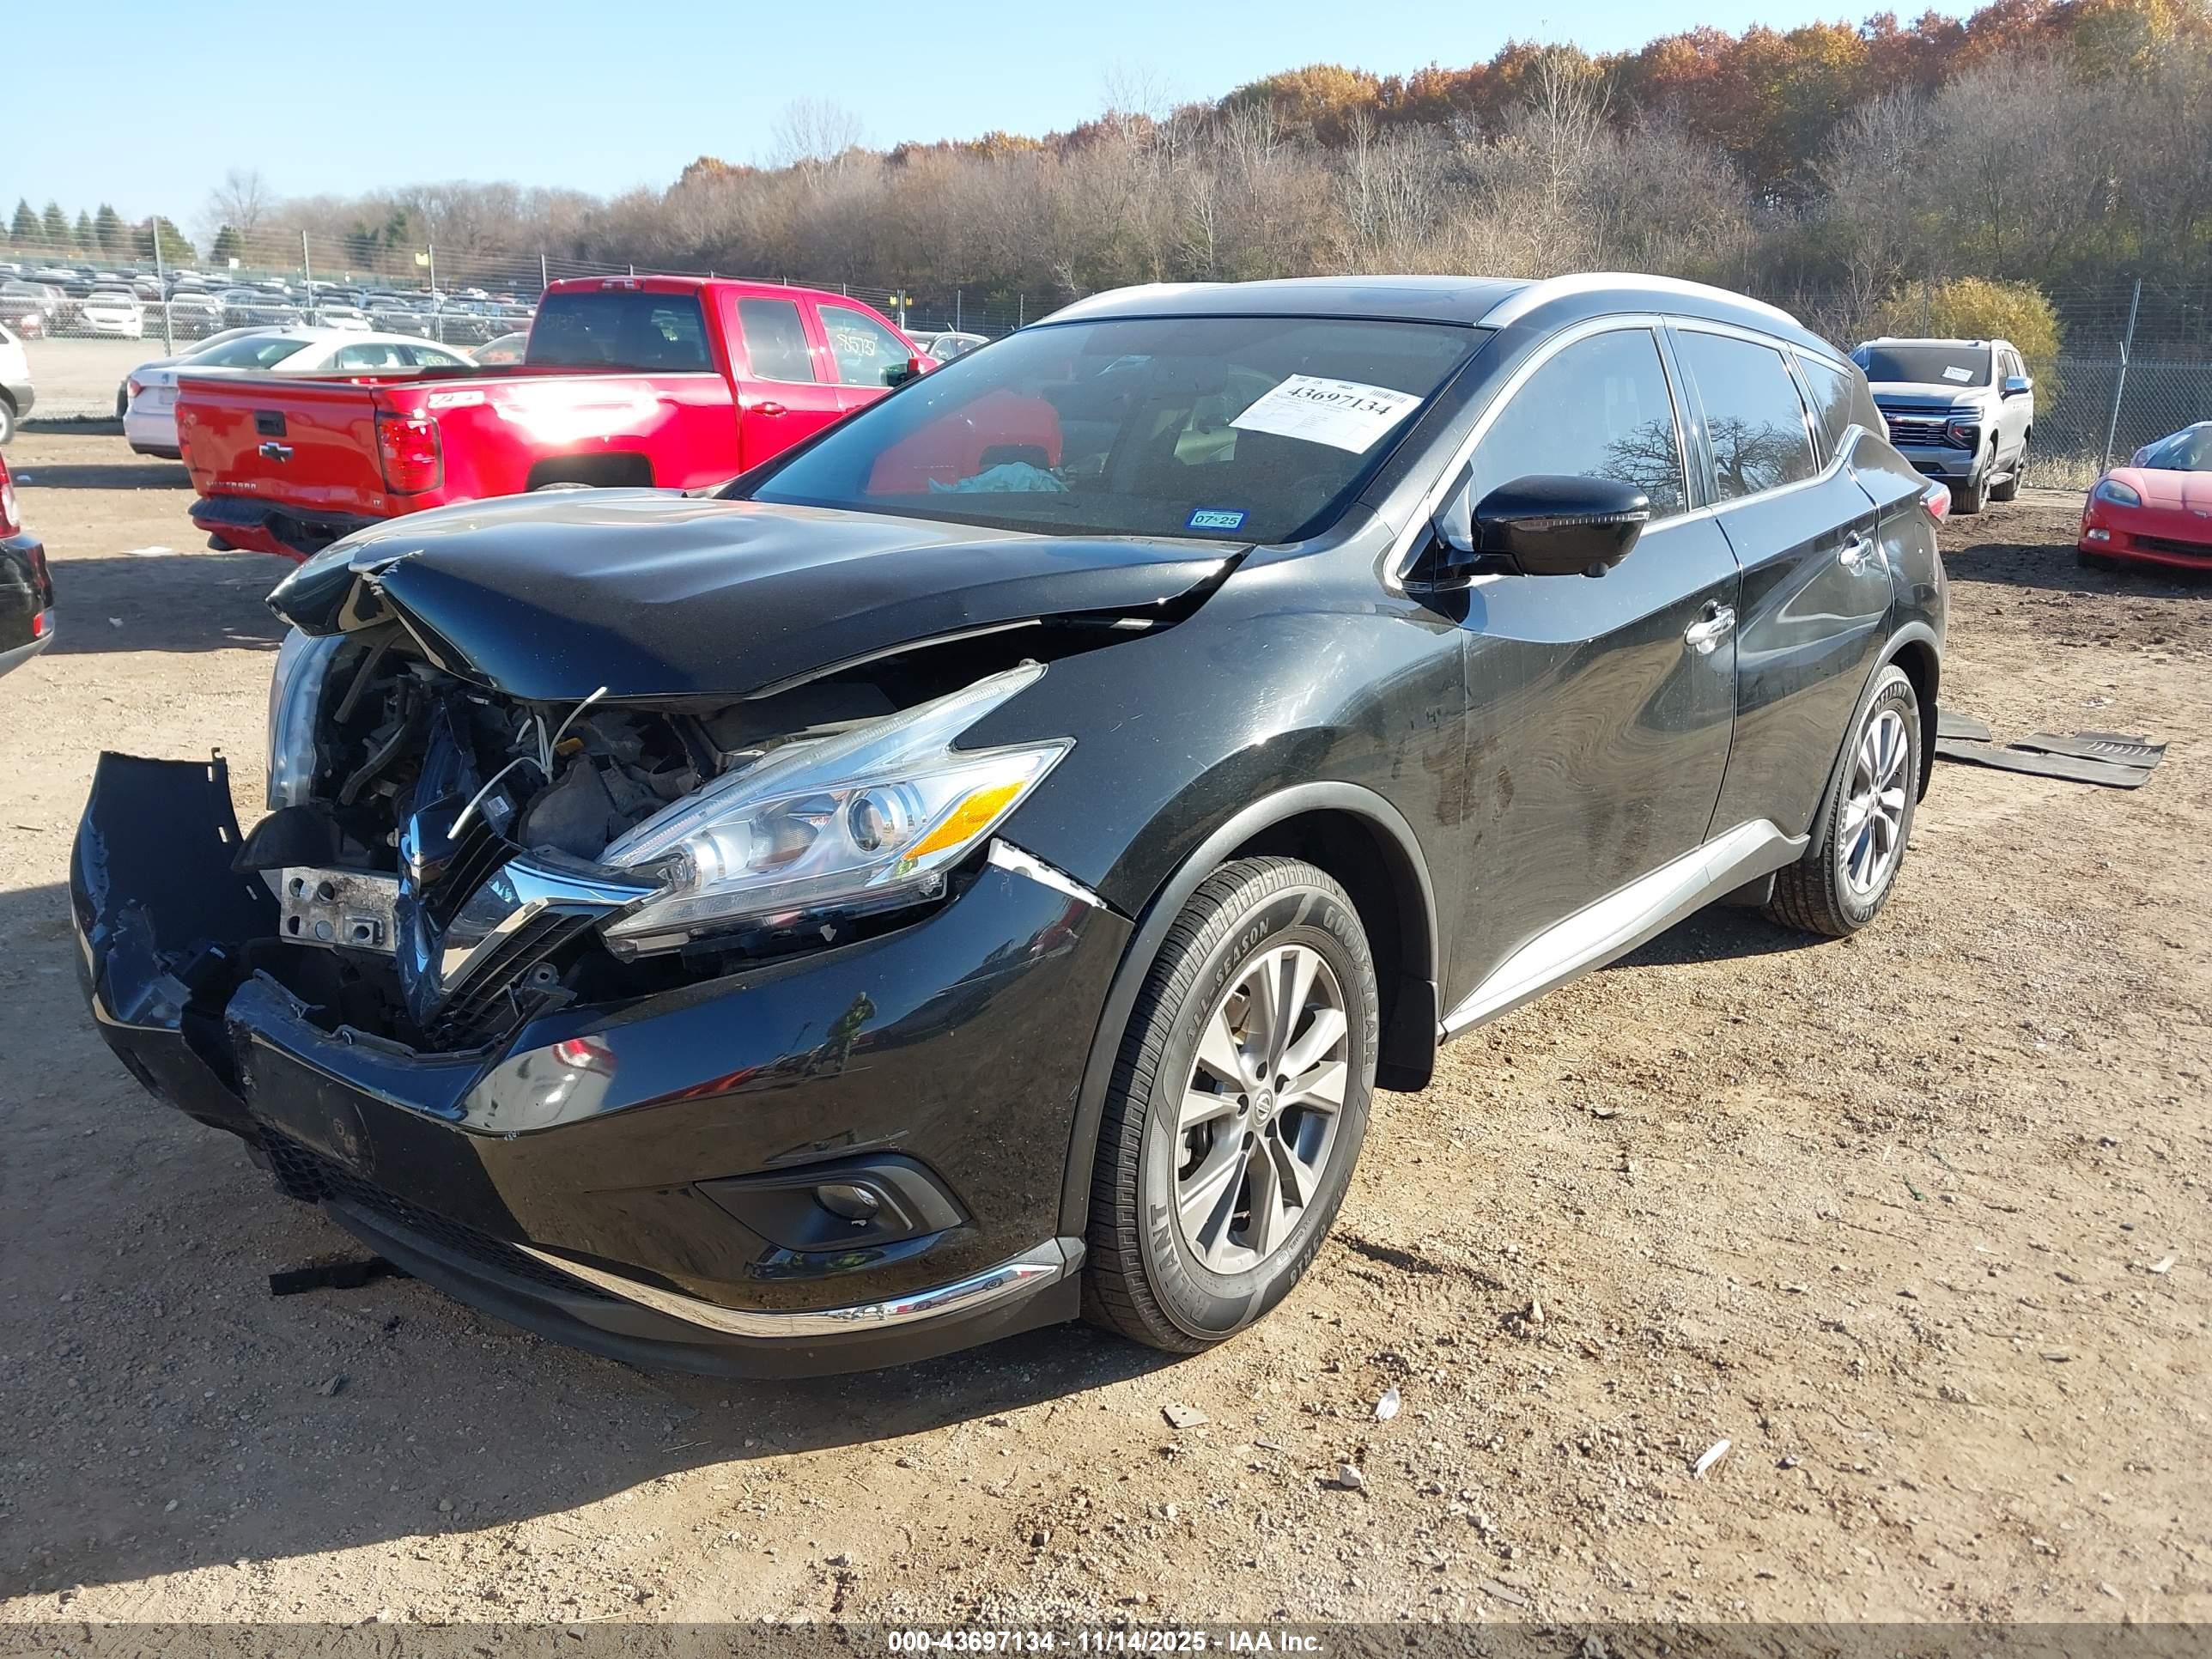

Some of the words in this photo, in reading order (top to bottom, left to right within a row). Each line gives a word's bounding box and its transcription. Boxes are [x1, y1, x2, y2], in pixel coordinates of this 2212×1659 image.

[1287, 386, 1392, 416] 43697134
[1186, 917, 1270, 1048] ALL-SEASON
[1322, 905, 1376, 1066] GOODYEAR
[1151, 1204, 1212, 1323] RELIANT
